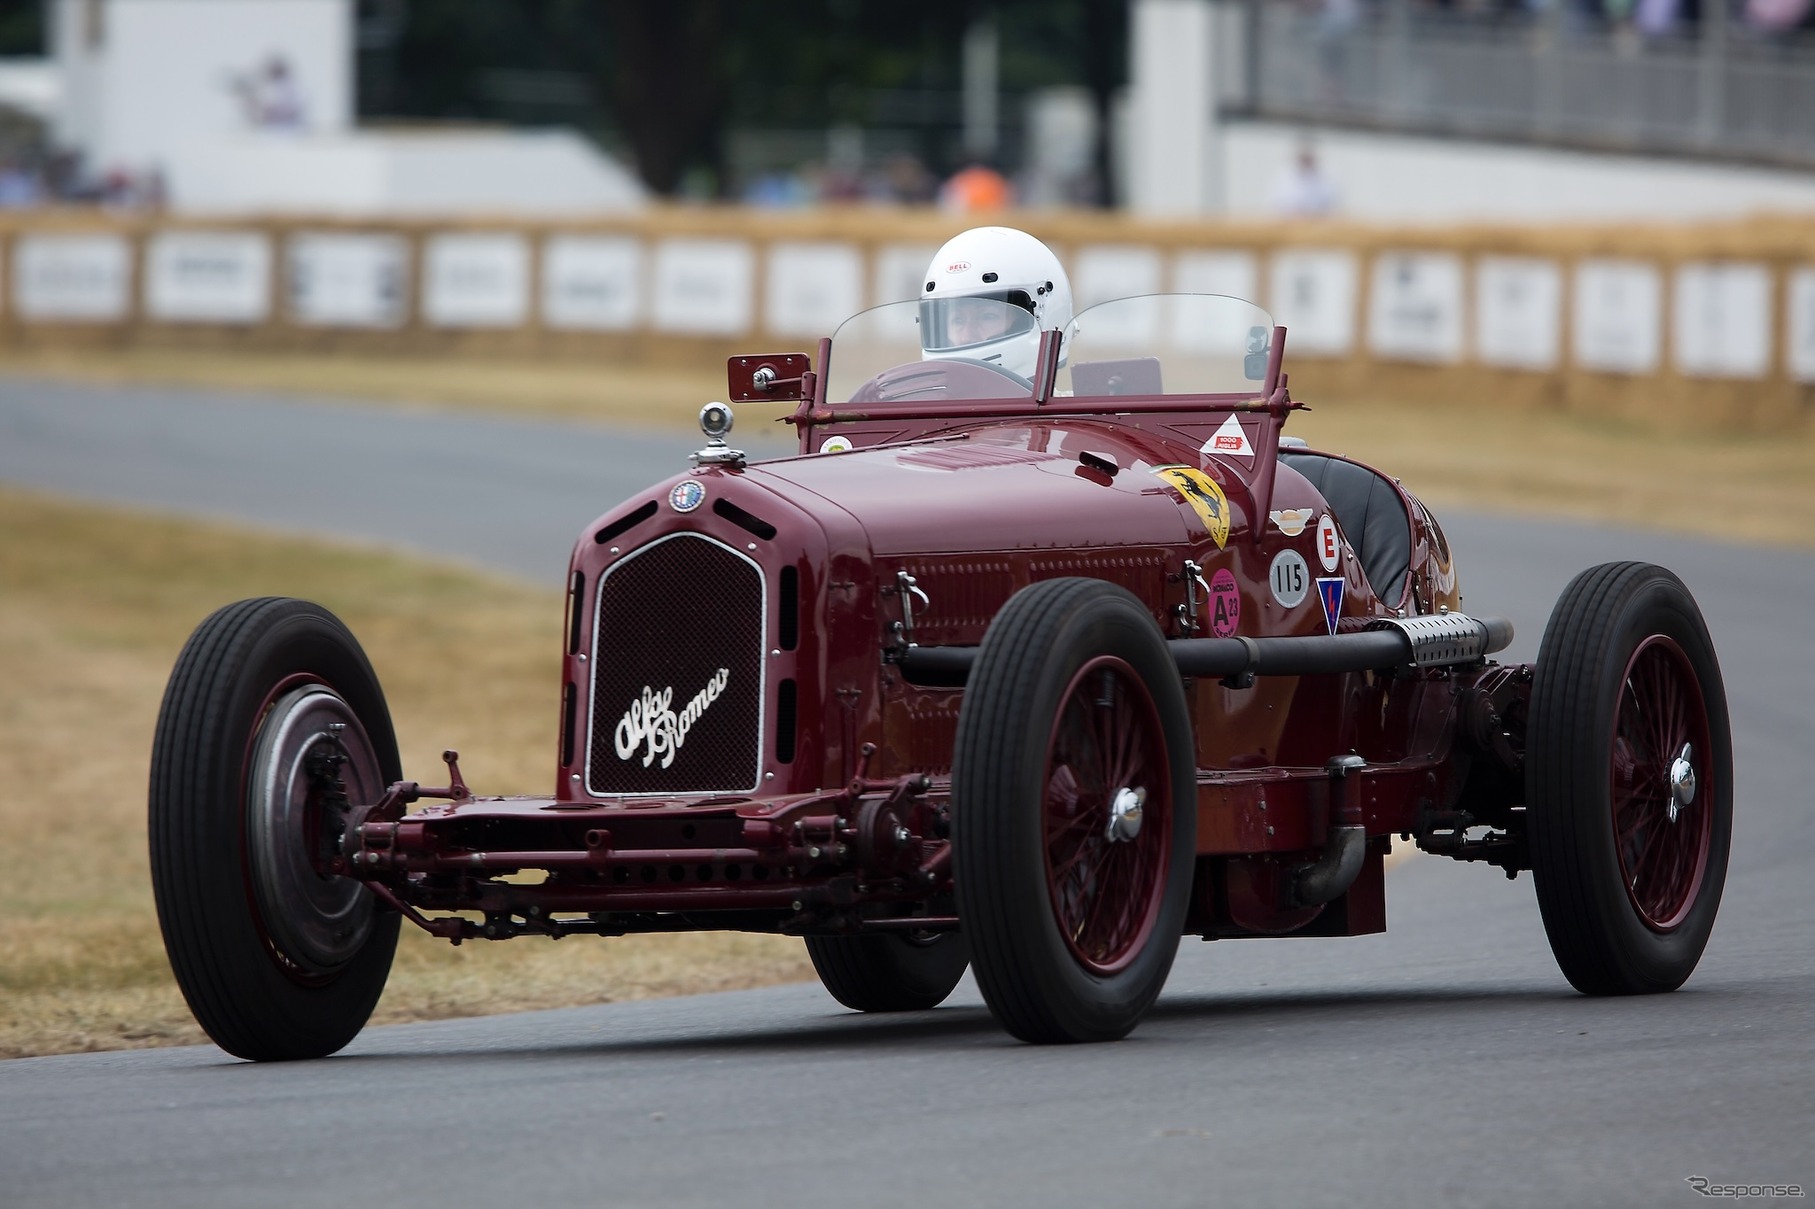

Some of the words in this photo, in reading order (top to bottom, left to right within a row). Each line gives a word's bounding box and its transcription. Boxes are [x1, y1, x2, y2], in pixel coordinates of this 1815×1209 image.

[949, 263, 967, 271] BELL
[1323, 528, 1335, 558] E
[1277, 564, 1301, 592] 115
[1213, 595, 1230, 627] A
[1228, 597, 1238, 617] 23
